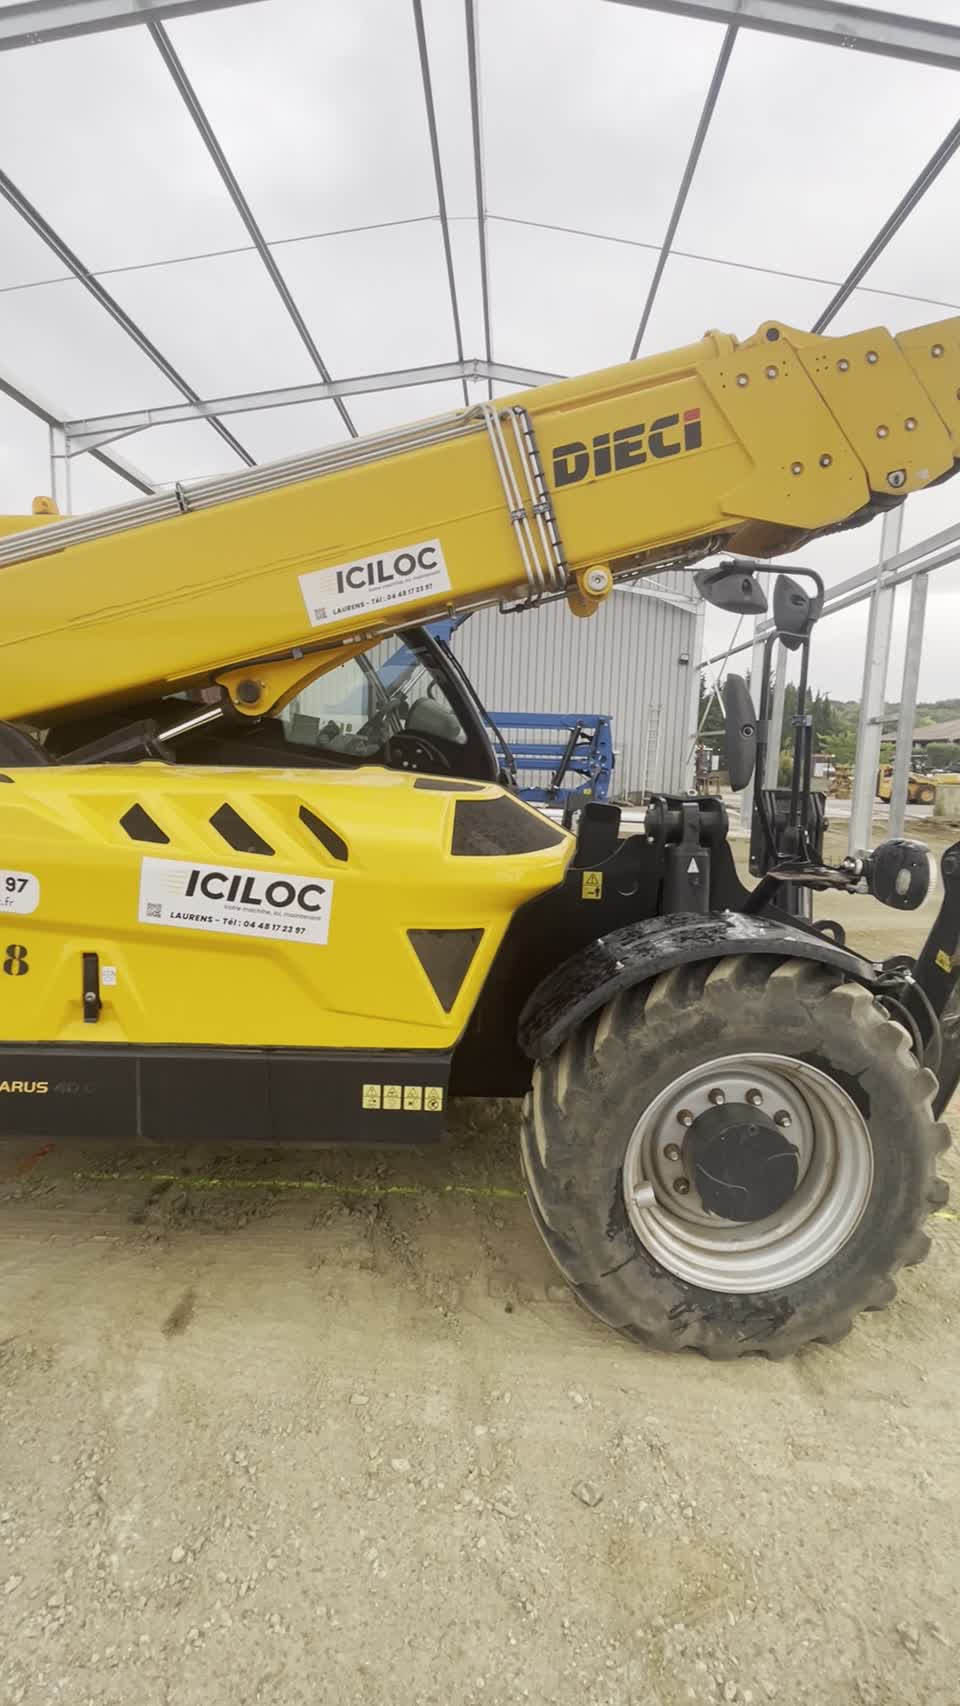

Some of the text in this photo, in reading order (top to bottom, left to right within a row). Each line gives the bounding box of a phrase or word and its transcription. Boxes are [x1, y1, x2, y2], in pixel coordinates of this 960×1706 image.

[336, 547, 438, 594] ICILOC
[333, 602, 365, 615] LAURENS
[6, 877, 29, 893] 97
[185, 870, 326, 912] ICILOC
[170, 912, 213, 922] LAURENS
[3, 944, 29, 976] 8
[0, 1081, 48, 1093] ARUS
